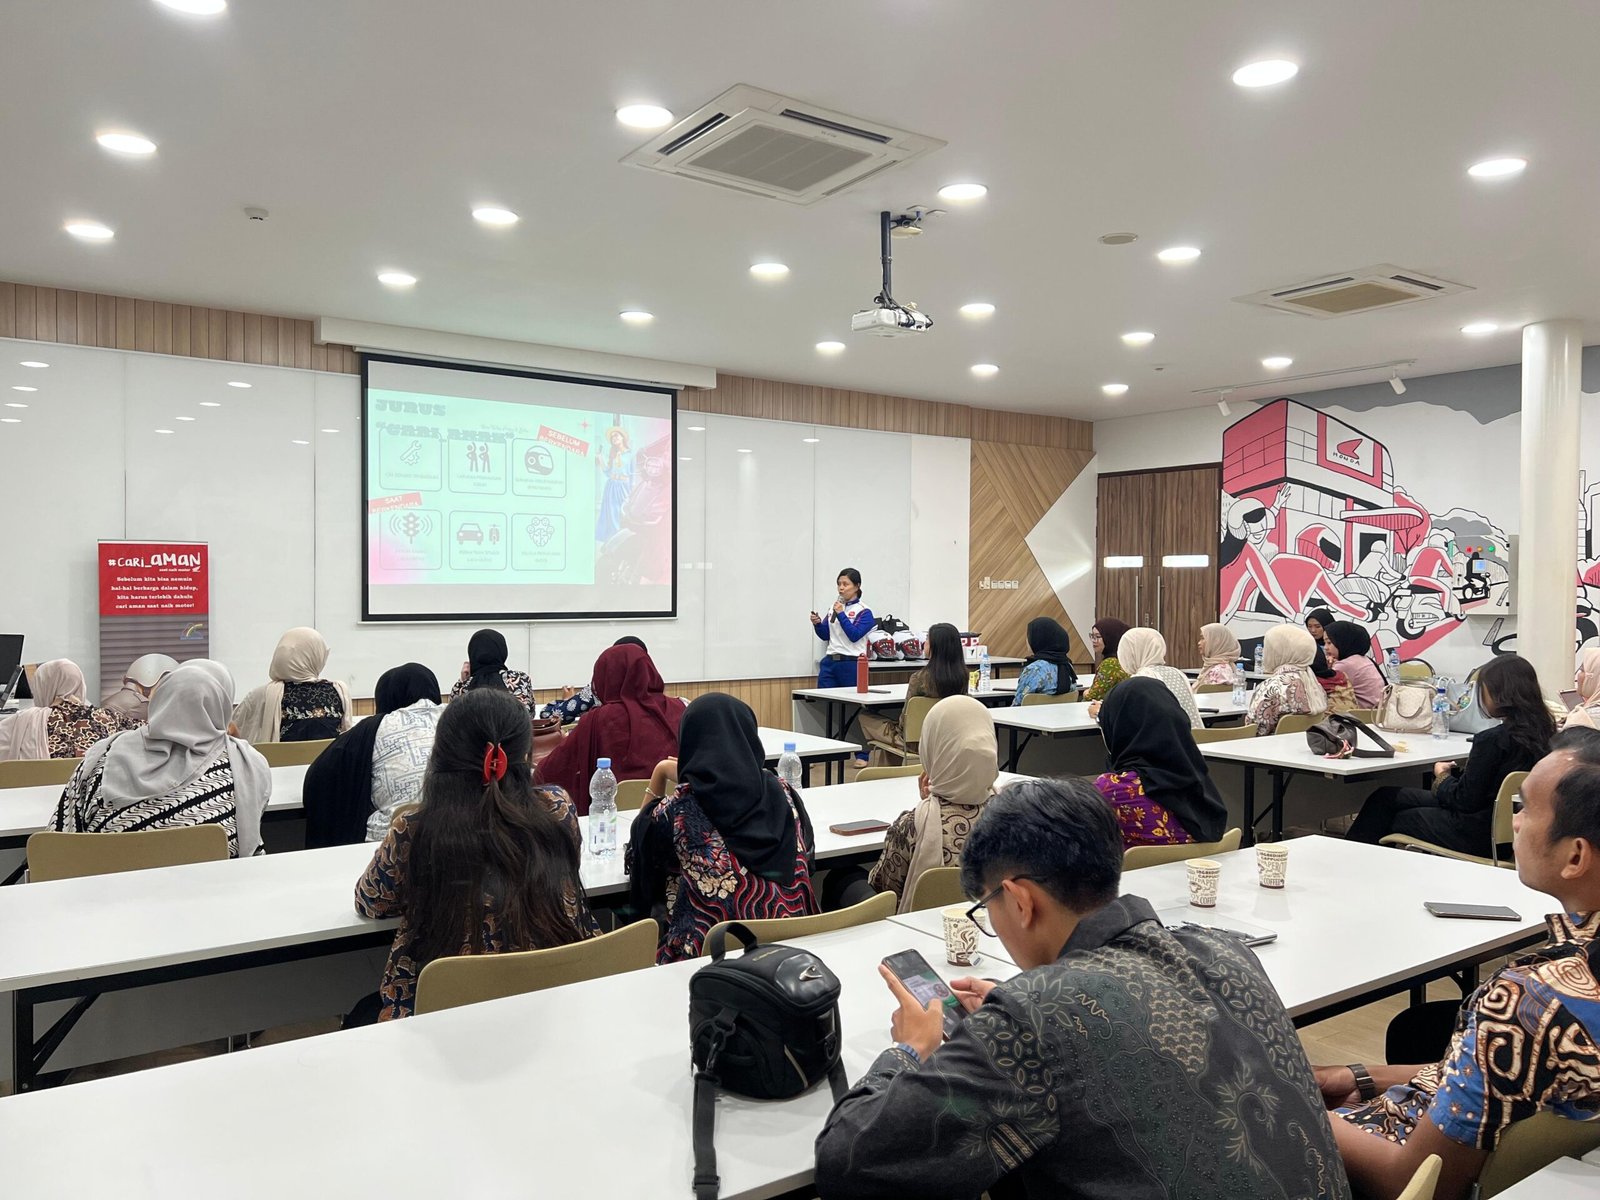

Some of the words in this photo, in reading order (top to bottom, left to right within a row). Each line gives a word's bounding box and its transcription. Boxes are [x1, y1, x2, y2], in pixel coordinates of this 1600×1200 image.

[375, 399, 446, 416] JURUS
[548, 429, 582, 447] SEBELUM
[1332, 452, 1361, 466] HONDA
